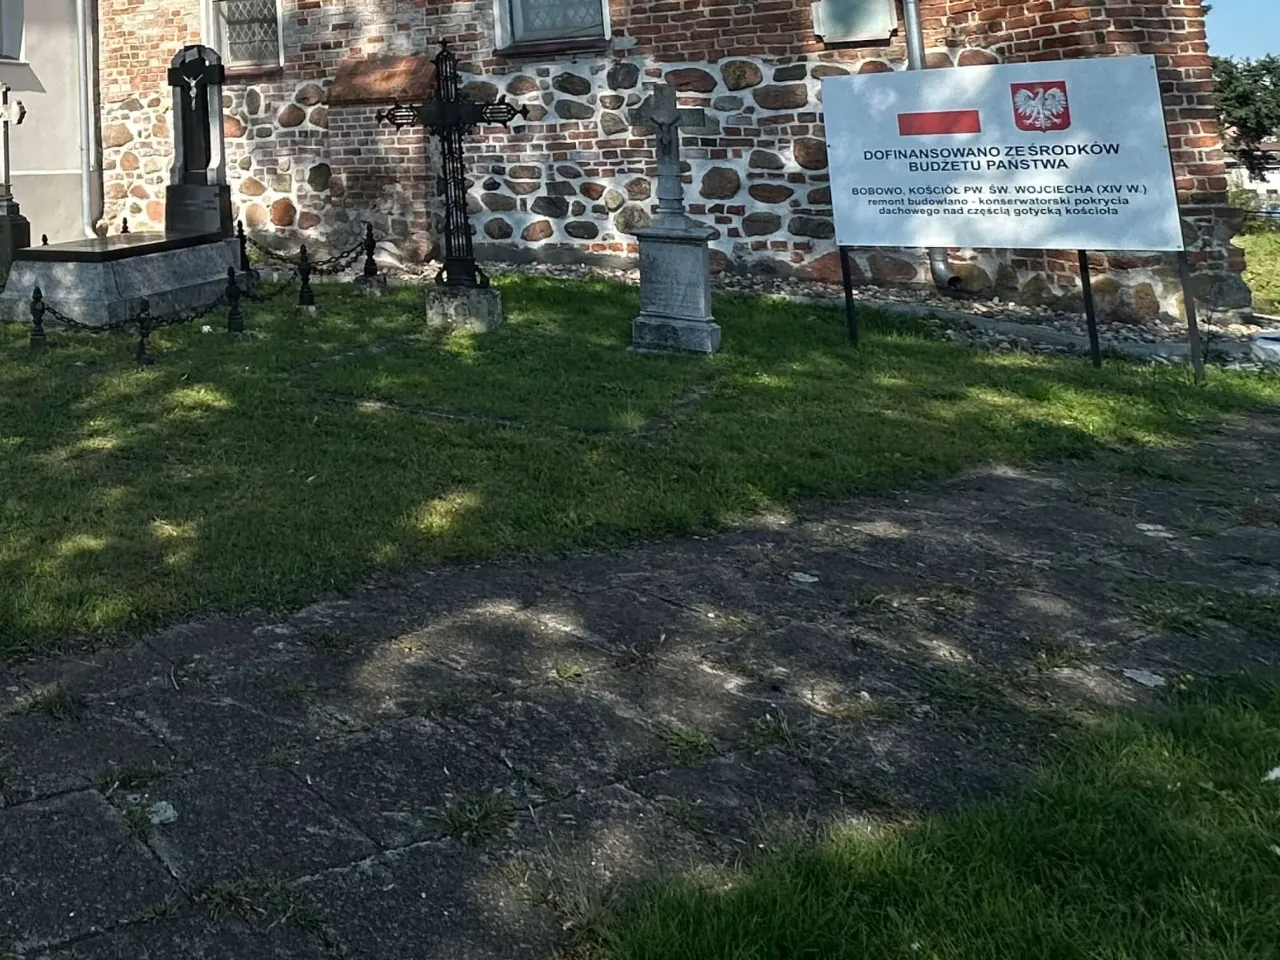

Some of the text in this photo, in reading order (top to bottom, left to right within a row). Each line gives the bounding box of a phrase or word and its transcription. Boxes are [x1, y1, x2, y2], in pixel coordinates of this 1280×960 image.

[863, 142, 1120, 160] DOFINANSOWANO ZE ŚRODKÓW
[909, 156, 1069, 172] BUDŻETU PAŃSTWA
[908, 185, 960, 195] KOŚCIÓŁ
[1014, 185, 1094, 194] WOJCIECHA
[1096, 184, 1123, 195] (XIV
[1126, 184, 1147, 195] W.)
[868, 198, 905, 206] remont
[907, 197, 968, 206] budowlano
[978, 196, 1070, 206] konserwatorski
[1074, 196, 1129, 207] pokrycia
[878, 206, 1118, 216] dachowego nad częścią gotycką kościoła
